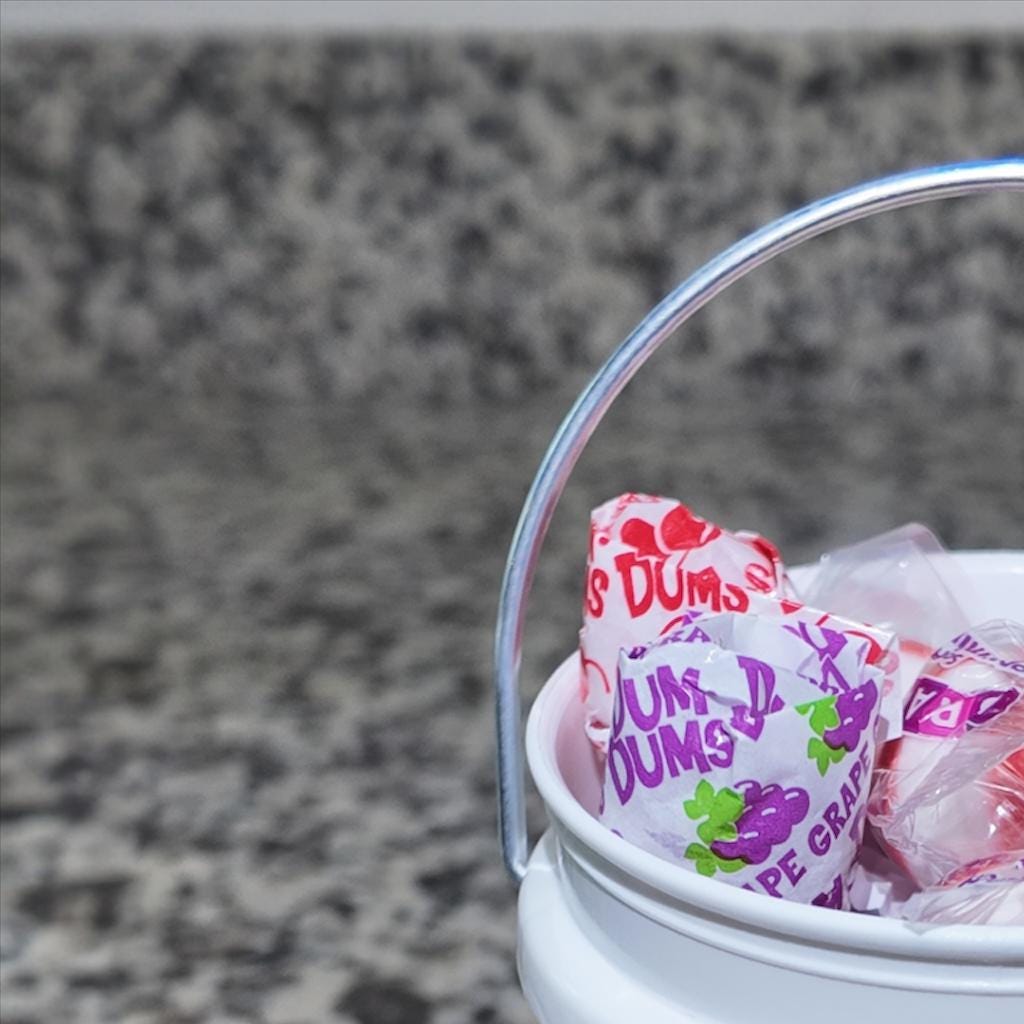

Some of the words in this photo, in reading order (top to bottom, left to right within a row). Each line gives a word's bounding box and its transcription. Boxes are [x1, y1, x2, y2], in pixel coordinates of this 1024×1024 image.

[614, 552, 750, 620] DUMS
[608, 720, 735, 806] DUMS
[741, 848, 808, 899] PE
[807, 741, 870, 857] GRAPE
